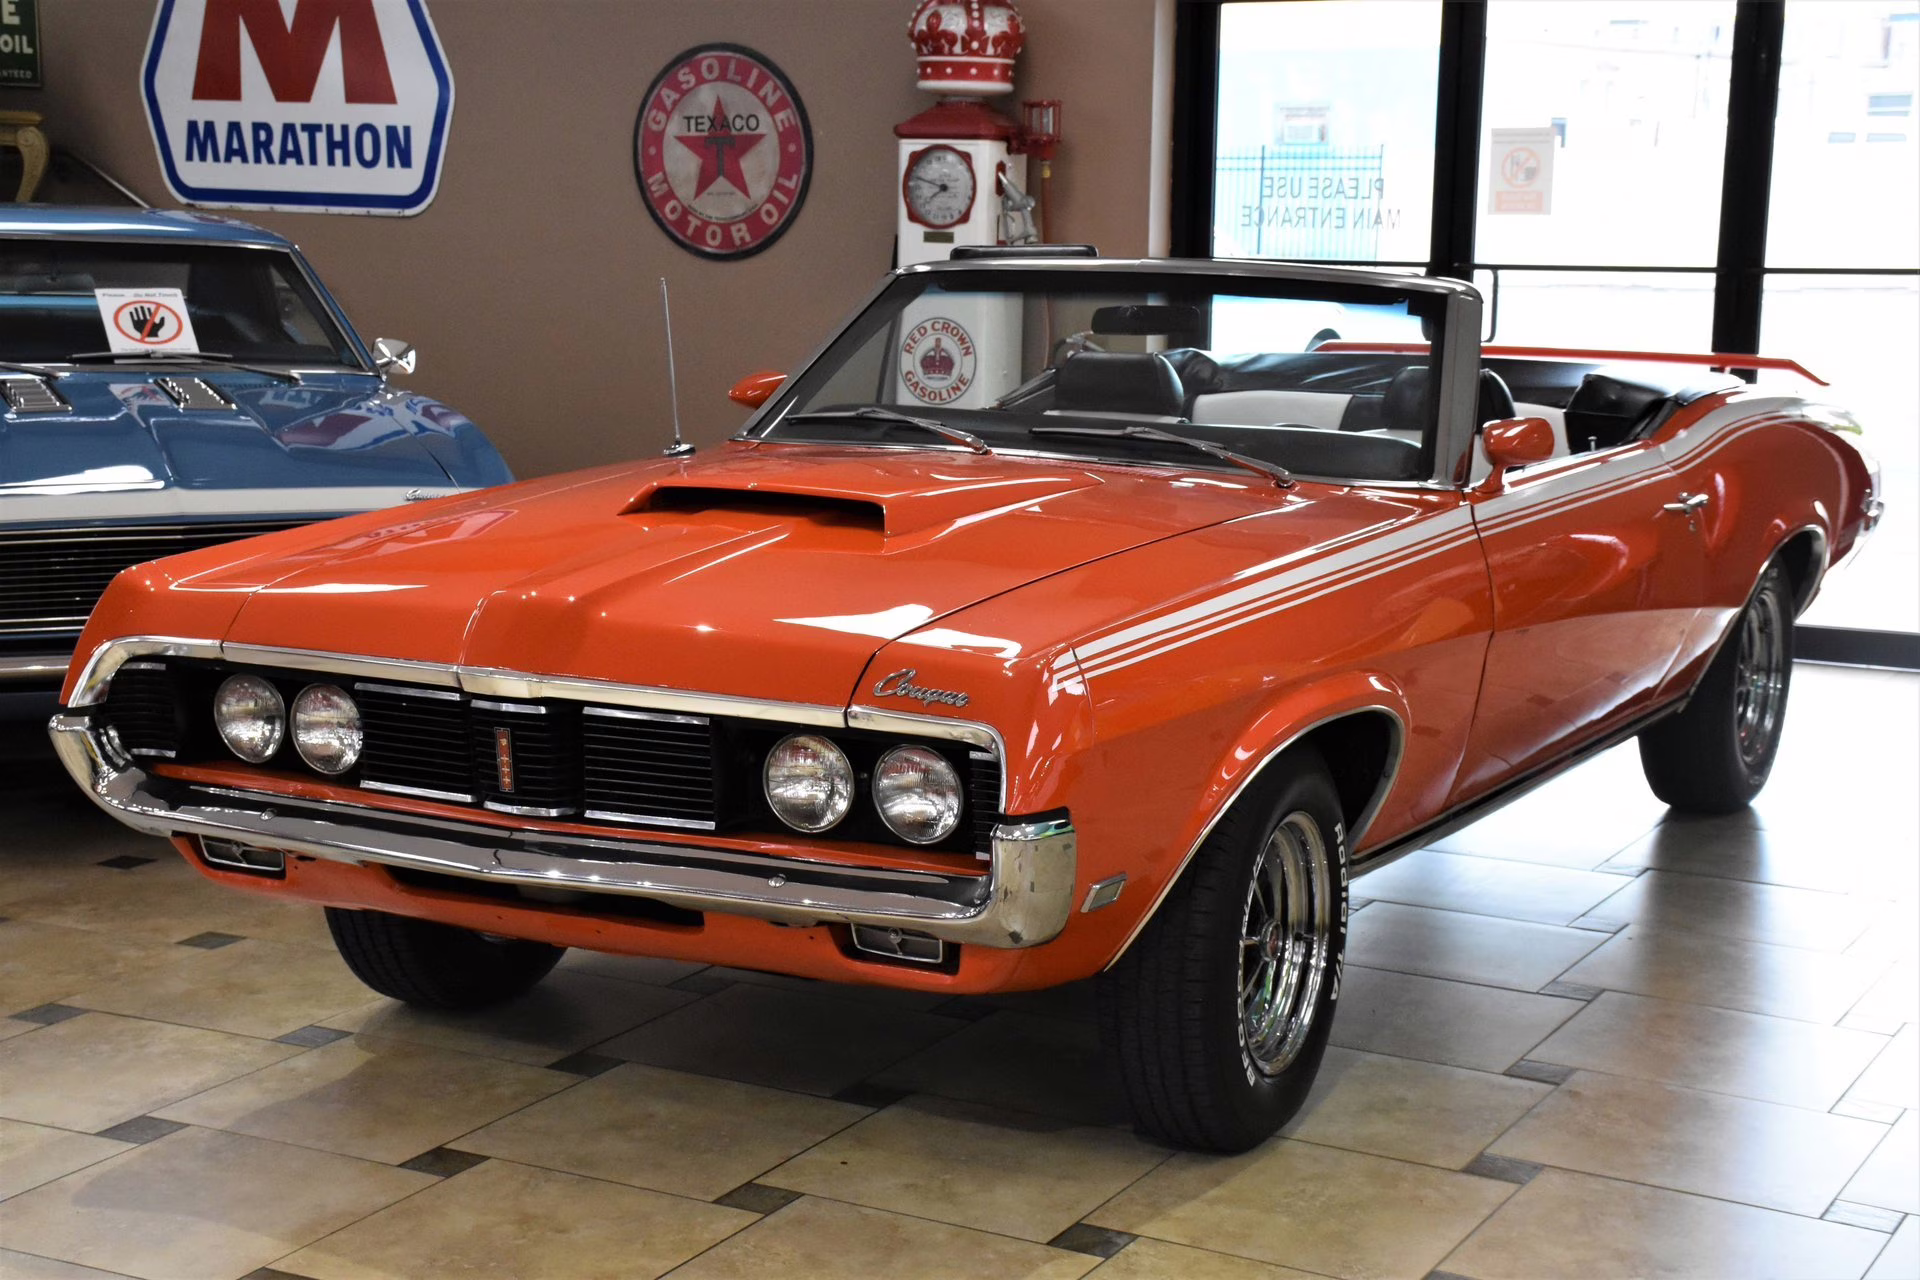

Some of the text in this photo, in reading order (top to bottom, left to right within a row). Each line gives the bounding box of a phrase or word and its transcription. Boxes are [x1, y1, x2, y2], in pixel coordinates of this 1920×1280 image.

[0, 34, 33, 54] OIL
[191, 0, 398, 104] M
[0, 69, 32, 79] NTEED
[648, 58, 795, 132] GASOLINE
[683, 114, 760, 132] TEXACO
[185, 120, 412, 169] MARATHON
[648, 172, 797, 246] MOTOR OIL
[903, 320, 973, 357] RED CROWN
[904, 370, 970, 401] GASOLINE
[873, 668, 969, 708] Cougar
